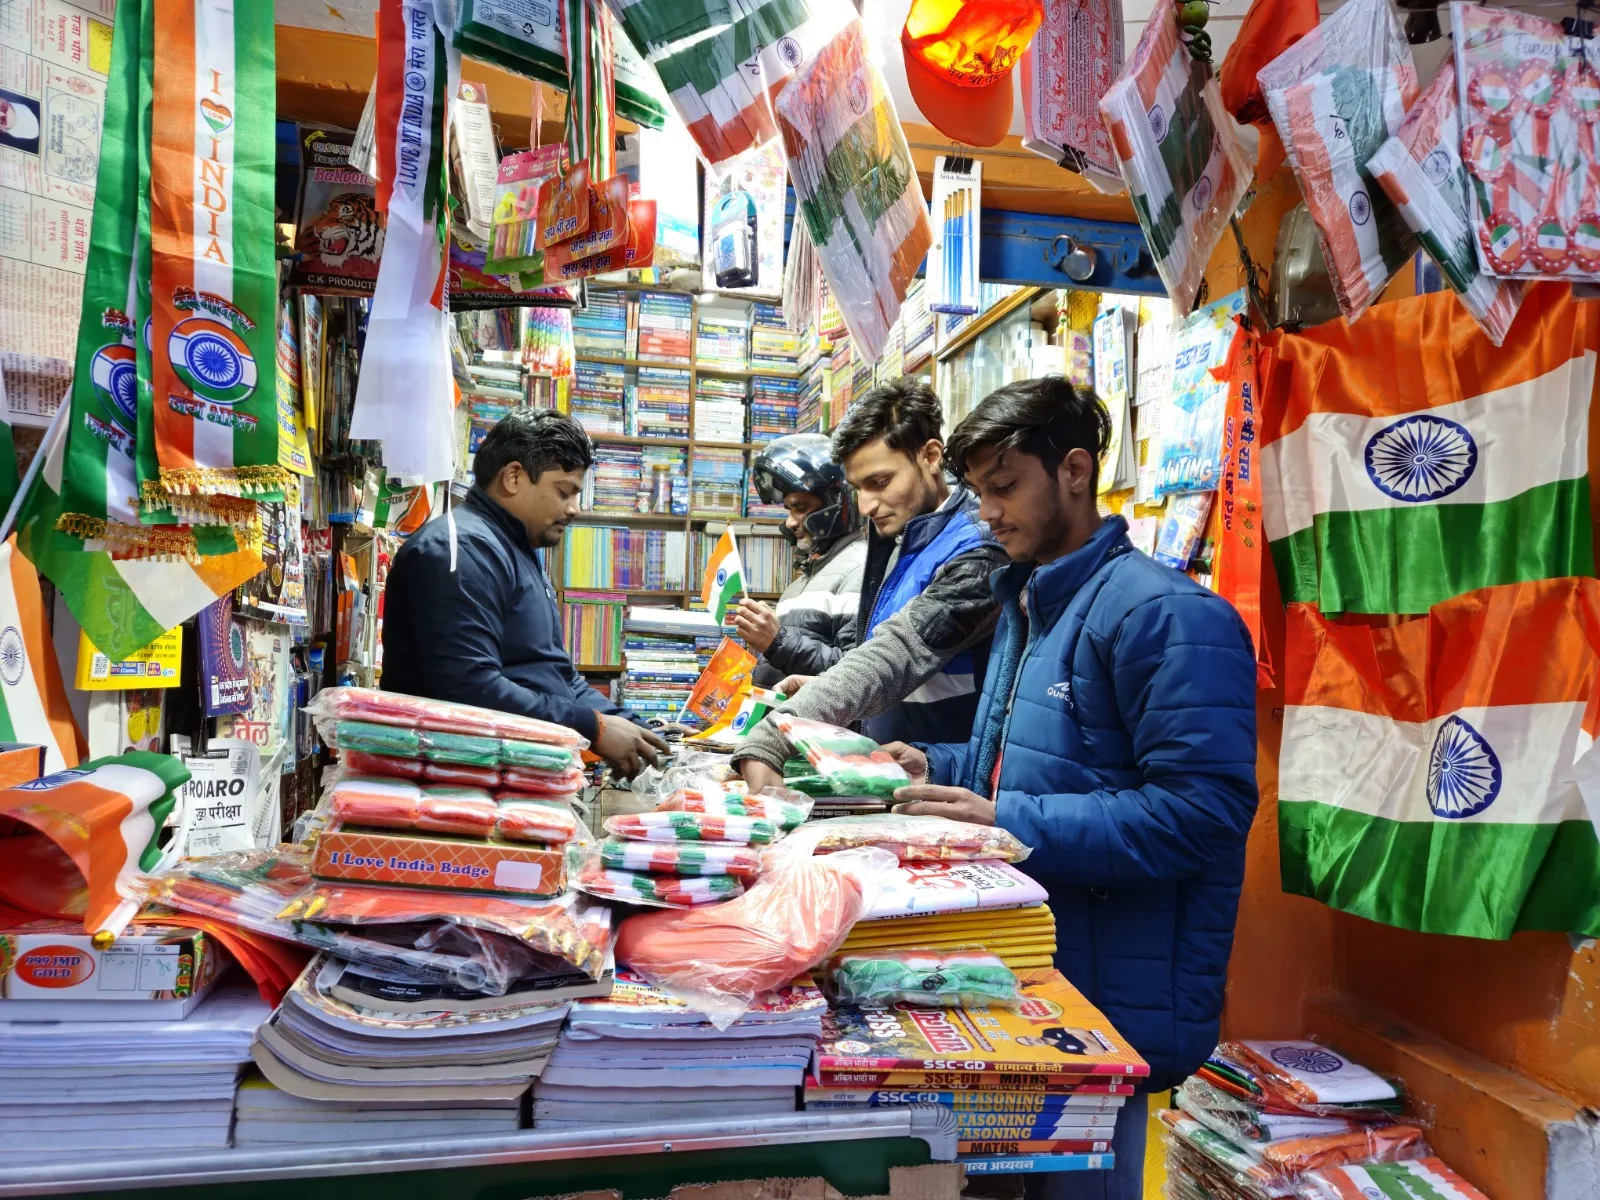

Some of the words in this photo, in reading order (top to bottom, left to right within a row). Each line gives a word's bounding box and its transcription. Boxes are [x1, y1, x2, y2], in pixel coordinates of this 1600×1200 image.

[410, 8, 426, 41] भारत
[406, 47, 425, 69] मेरा
[209, 69, 222, 94] I
[403, 93, 424, 128] INDIA
[403, 126, 421, 147] MY
[399, 147, 421, 179] LOVE
[200, 138, 228, 264] INDIA
[570, 240, 584, 252] जय
[598, 228, 614, 243] राम
[561, 262, 578, 276] जय
[580, 256, 593, 271] श्री
[595, 255, 611, 269] राम
[1241, 382, 1253, 415] जय
[1240, 417, 1255, 444] श्री
[1157, 456, 1213, 488] AINTING
[1238, 447, 1251, 482] राम
[209, 802, 241, 820] परीक्षा
[330, 852, 339, 864] I
[343, 853, 384, 868] Love
[389, 857, 435, 872] India
[440, 862, 489, 878] Badge
[25, 956, 49, 966] 999
[51, 956, 81, 966] JMD
[33, 968, 71, 978] GOLD
[923, 1059, 986, 1071] SSC-GD
[994, 1063, 1033, 1072] सामान्य
[1035, 1062, 1064, 1072] हिन्दी
[925, 1073, 981, 1084] SSC-GD
[1000, 1074, 1049, 1084] MATHS
[878, 1091, 940, 1103] SSC-GD
[953, 1092, 1046, 1105] REASONING
[957, 1114, 1037, 1126] EASONING
[957, 1127, 1032, 1139] EASONING
[970, 1142, 1020, 1153] MATHS
[990, 1159, 1034, 1171] अध्ययन
